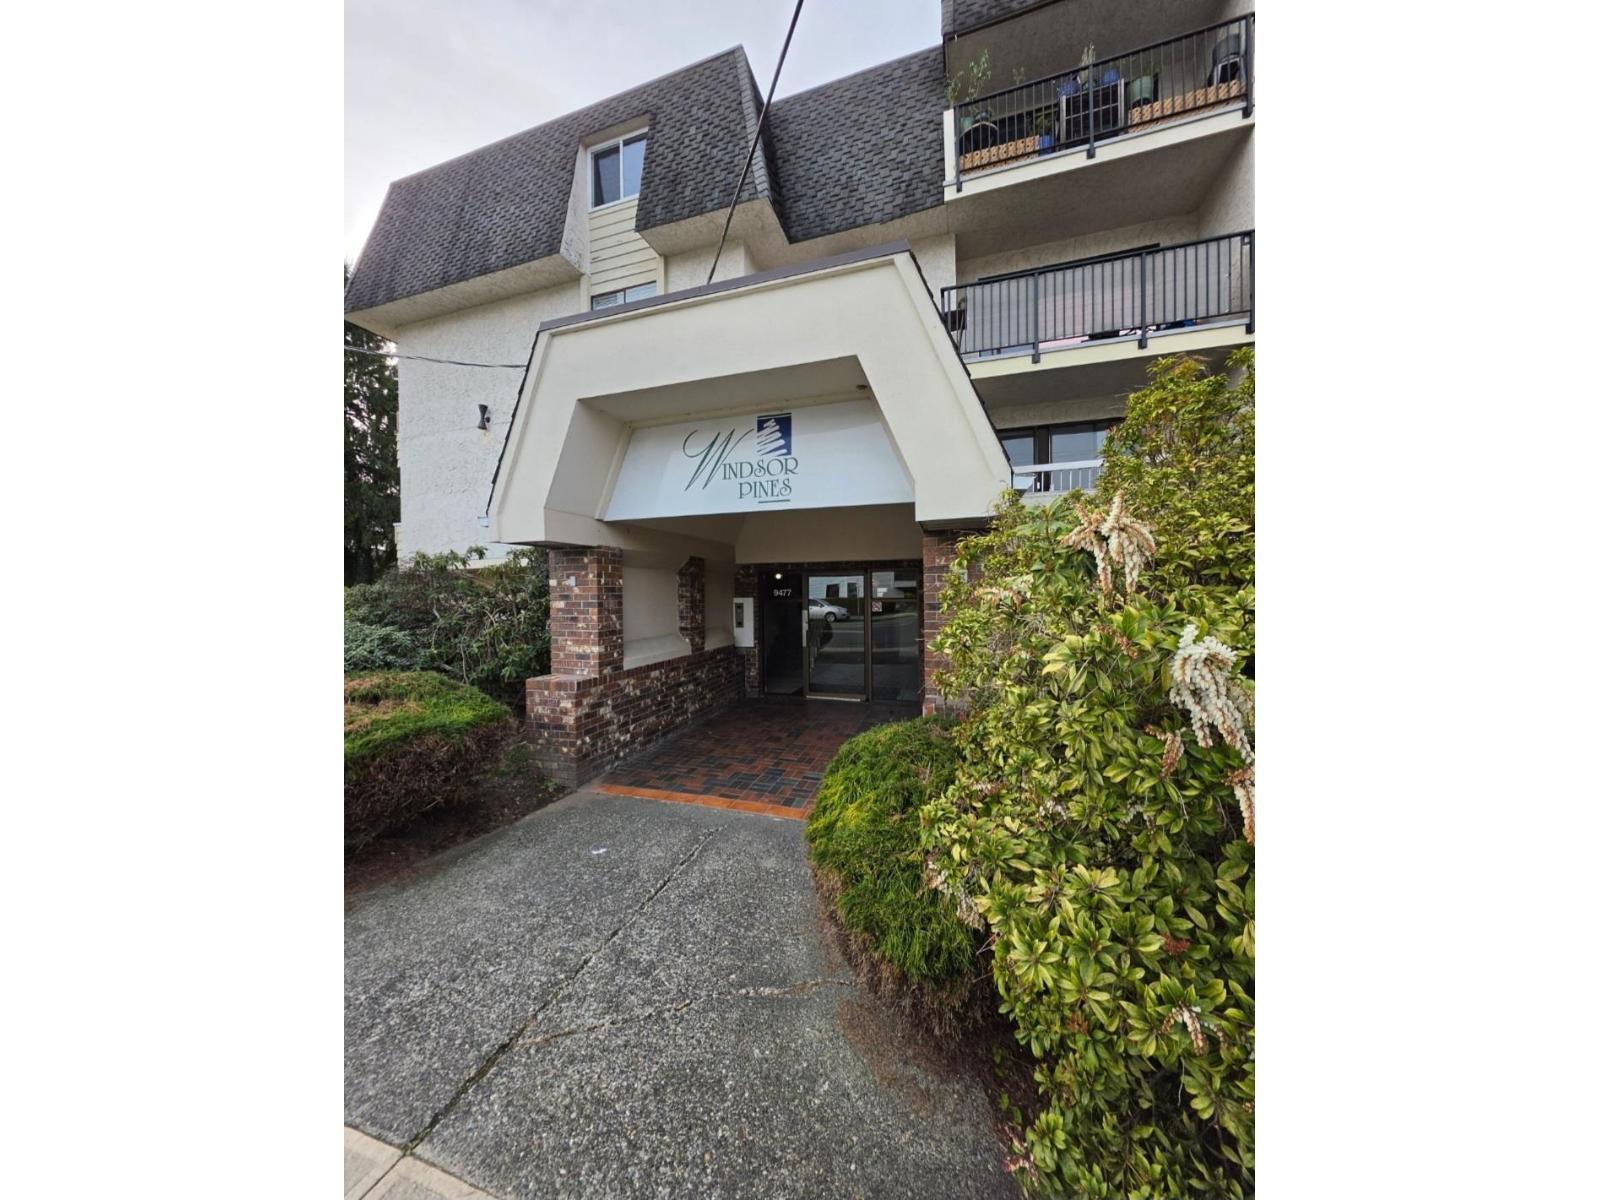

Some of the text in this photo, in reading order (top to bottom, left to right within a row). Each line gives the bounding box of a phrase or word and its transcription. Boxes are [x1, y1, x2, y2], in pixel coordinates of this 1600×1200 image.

[683, 428, 798, 491] WINDSOR
[738, 478, 792, 499] PINES
[773, 589, 791, 597] 9477
